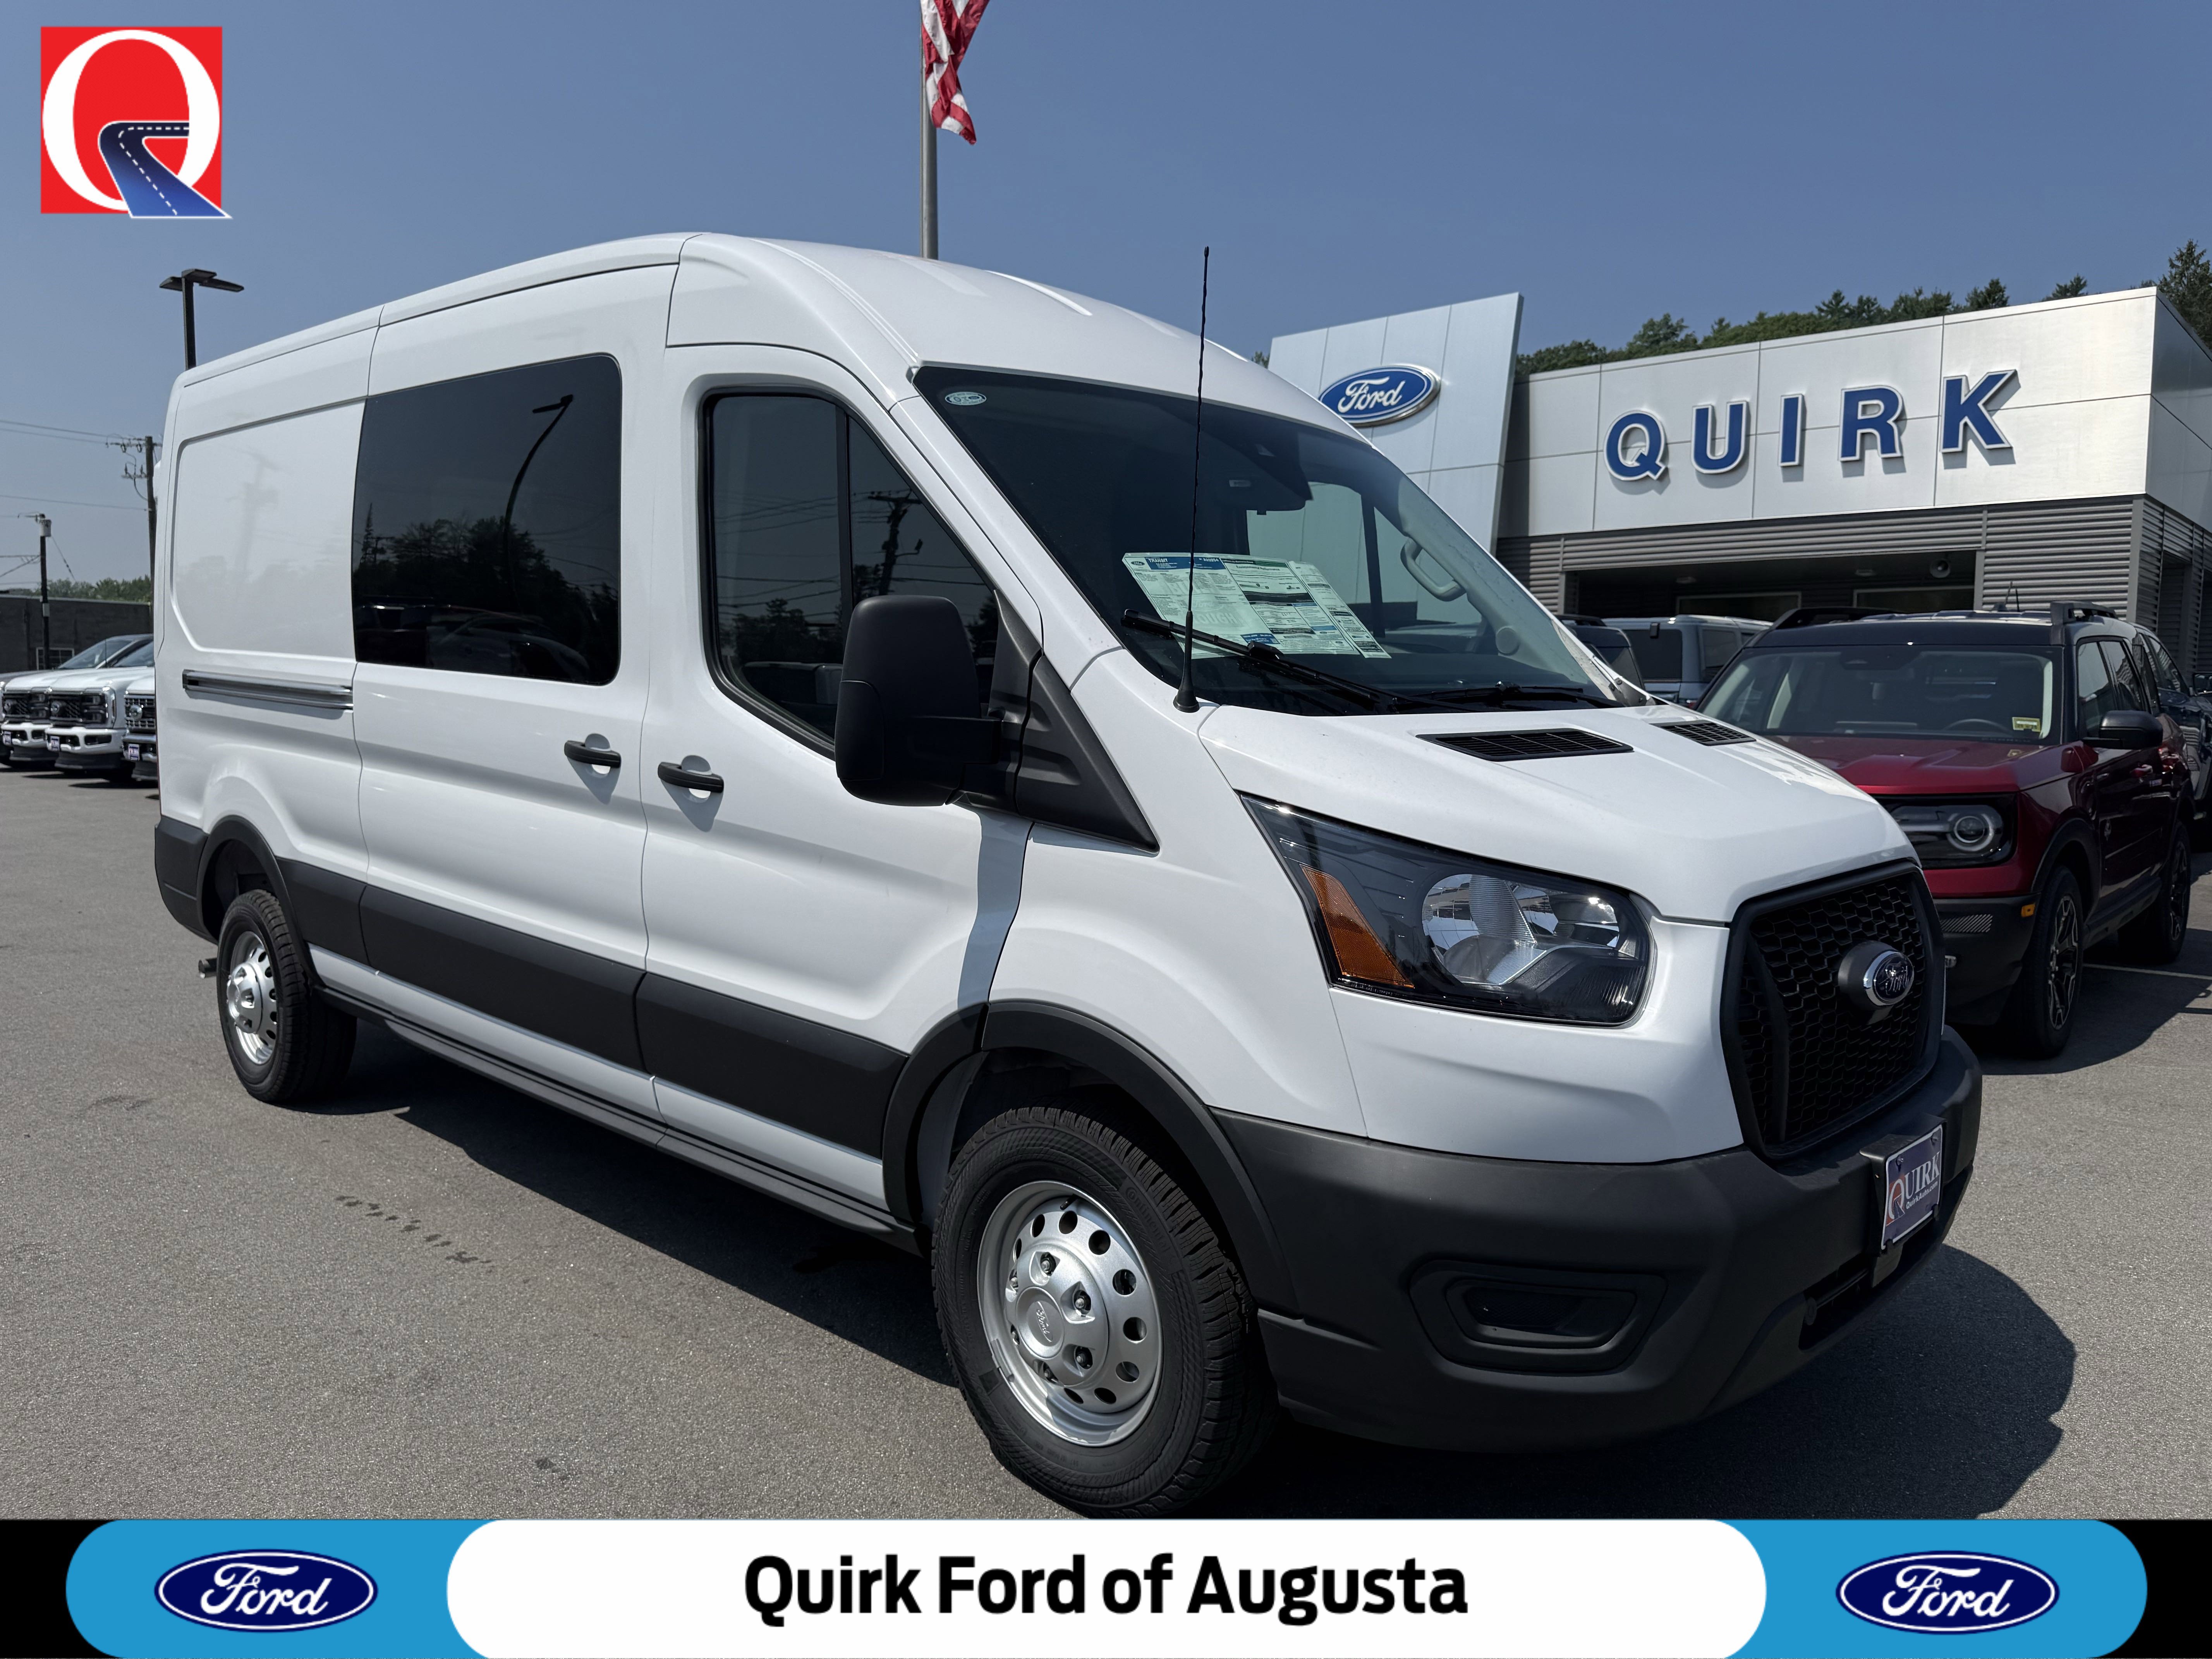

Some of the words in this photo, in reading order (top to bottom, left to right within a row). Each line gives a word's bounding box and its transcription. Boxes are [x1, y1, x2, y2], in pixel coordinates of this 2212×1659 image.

[1337, 375, 1406, 414] Ford
[1603, 369, 2017, 481] QUIRK
[1125, 1187, 1171, 1253] Continental
[1888, 1151, 1941, 1221] QUIRK
